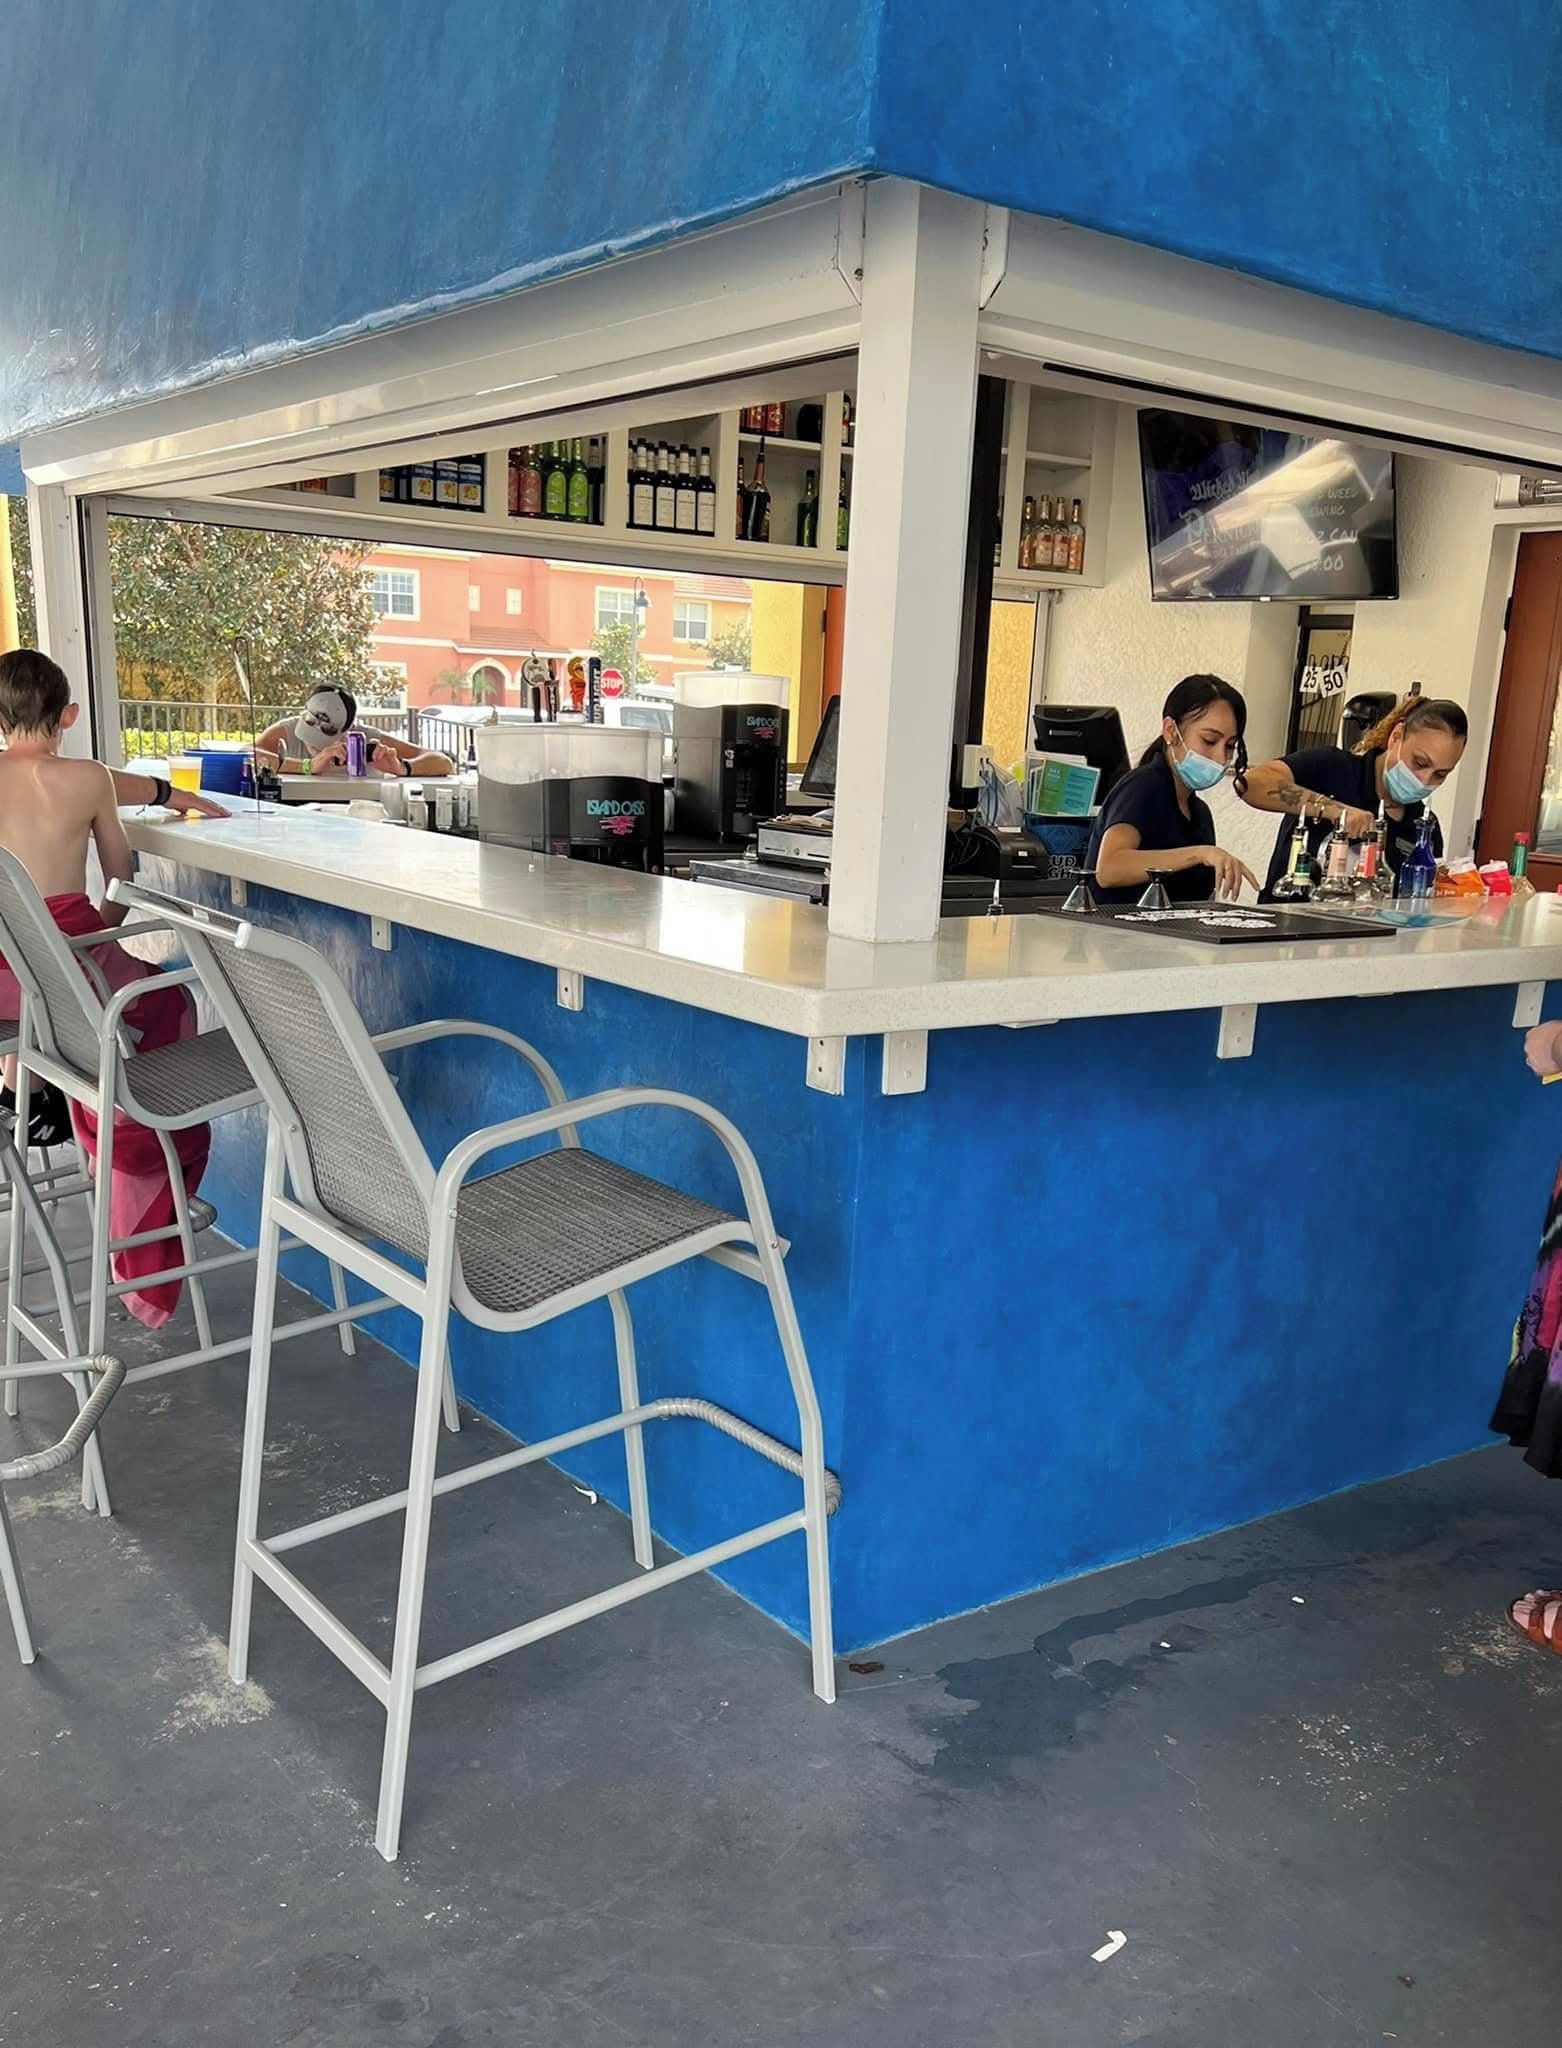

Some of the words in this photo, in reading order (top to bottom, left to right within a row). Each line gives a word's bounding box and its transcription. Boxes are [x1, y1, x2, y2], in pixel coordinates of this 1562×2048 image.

[602, 678, 624, 689] STOP
[1303, 671, 1318, 689] 25
[1322, 671, 1344, 692] 50
[1049, 854, 1078, 868] UD
